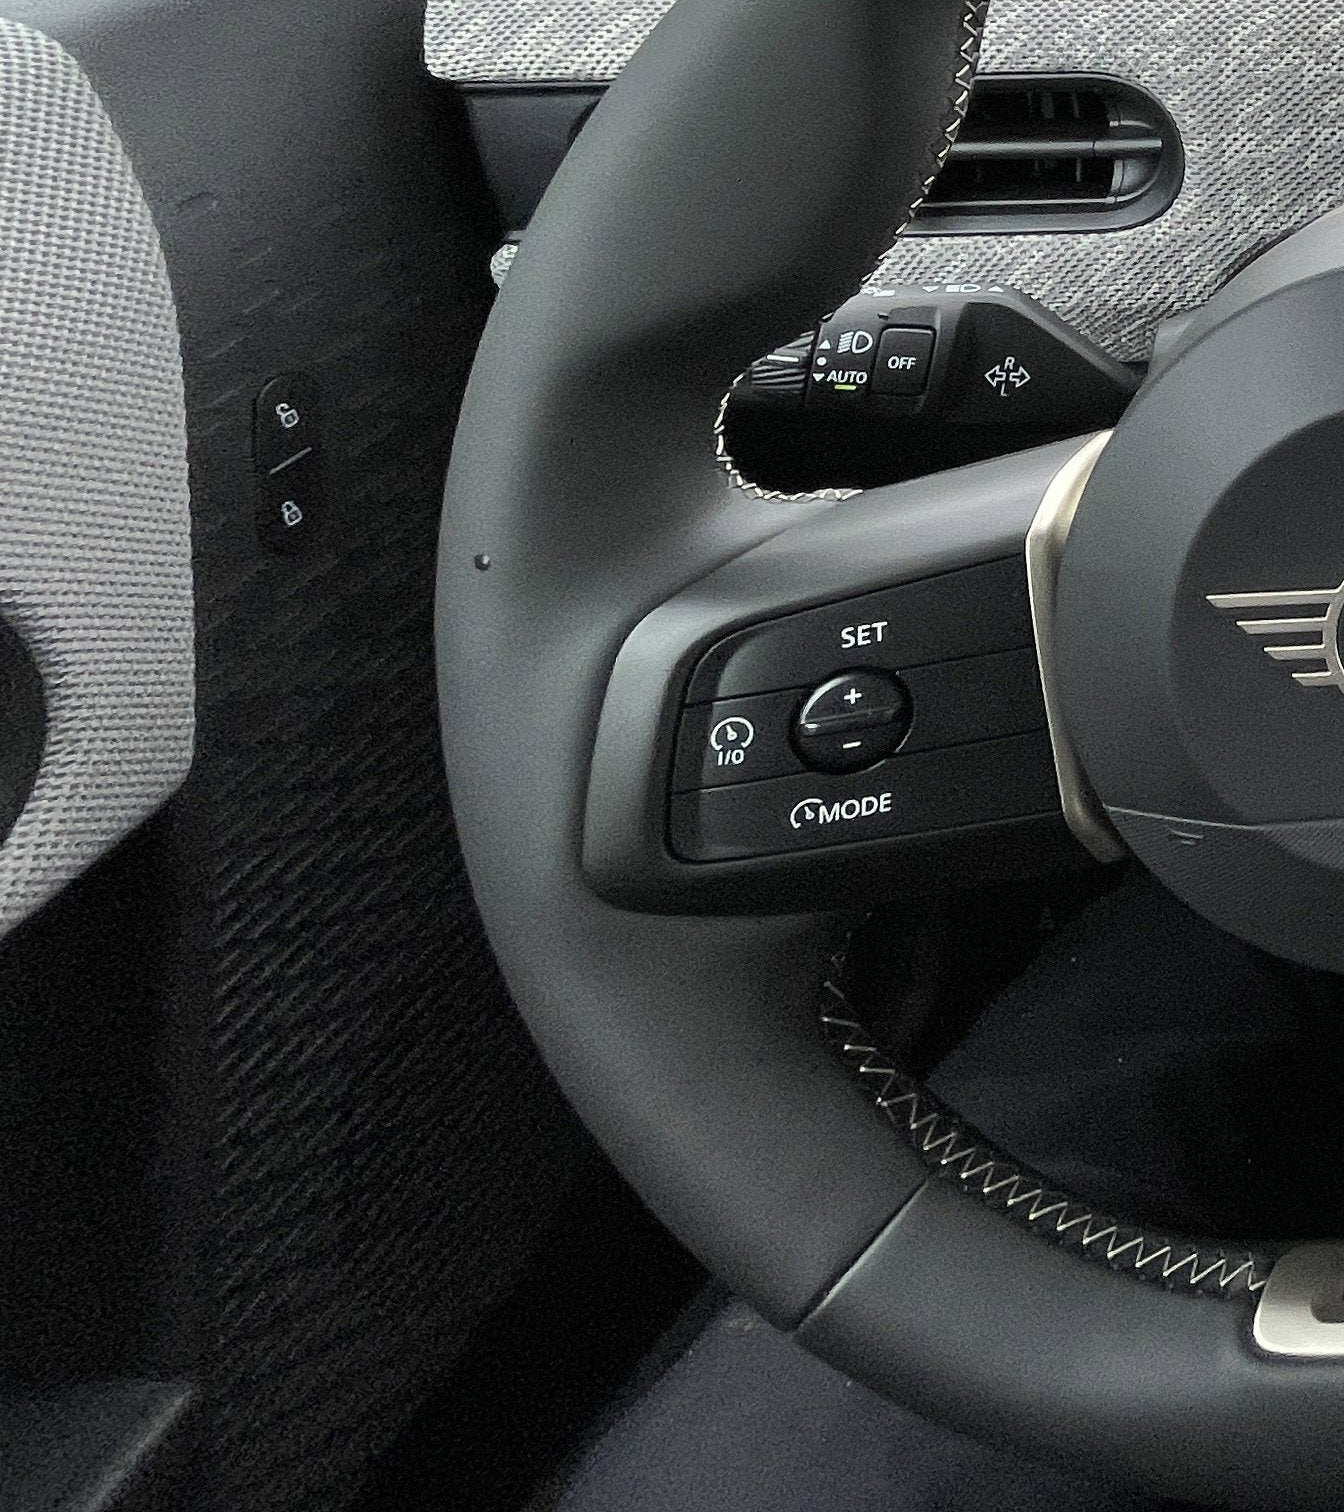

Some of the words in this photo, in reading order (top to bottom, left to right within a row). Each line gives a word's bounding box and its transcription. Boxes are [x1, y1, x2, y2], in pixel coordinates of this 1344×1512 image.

[887, 355, 917, 370] OFF
[1004, 356, 1016, 370] R
[826, 369, 868, 384] AUTO
[1000, 385, 1008, 397] L
[840, 621, 889, 649] SET
[818, 792, 893, 824] MODE
